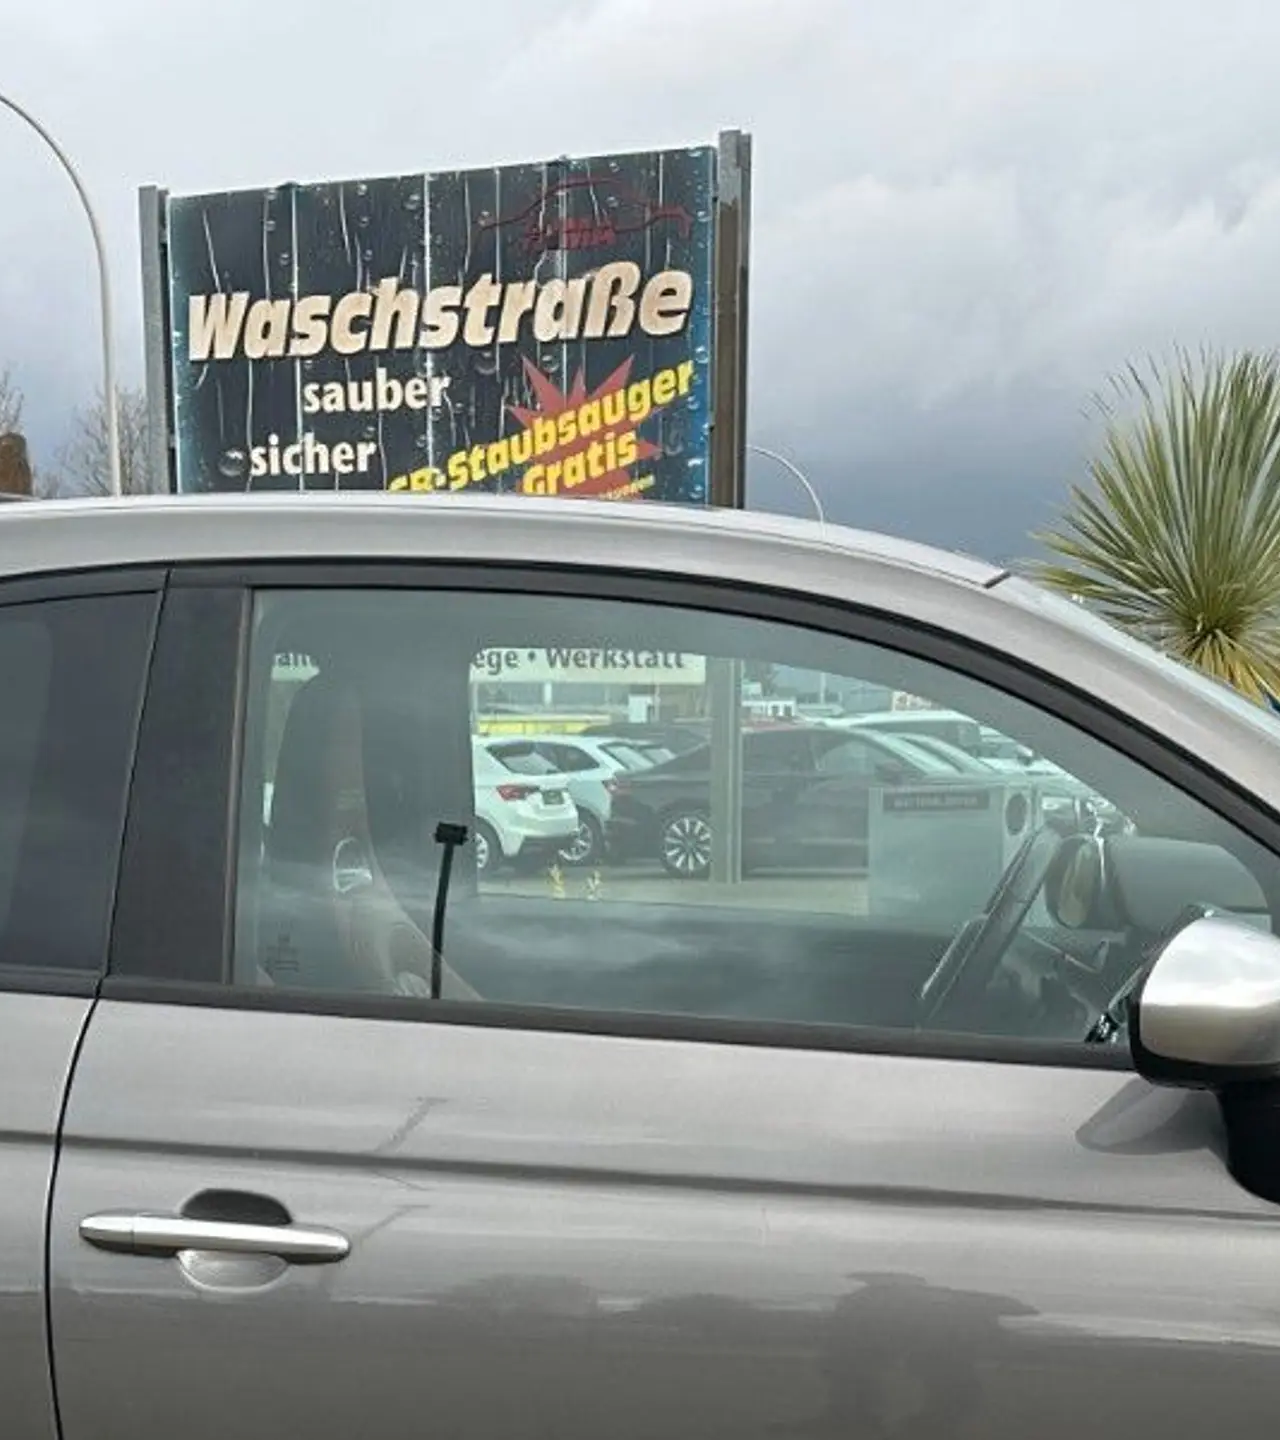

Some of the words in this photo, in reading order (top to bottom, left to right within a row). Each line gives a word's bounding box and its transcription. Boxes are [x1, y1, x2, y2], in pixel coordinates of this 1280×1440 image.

[187, 260, 693, 361] Waschstraße
[304, 368, 449, 413] sauber
[250, 433, 376, 476] sicher
[522, 431, 638, 494] Gratis
[546, 649, 685, 669] Werkstatt
